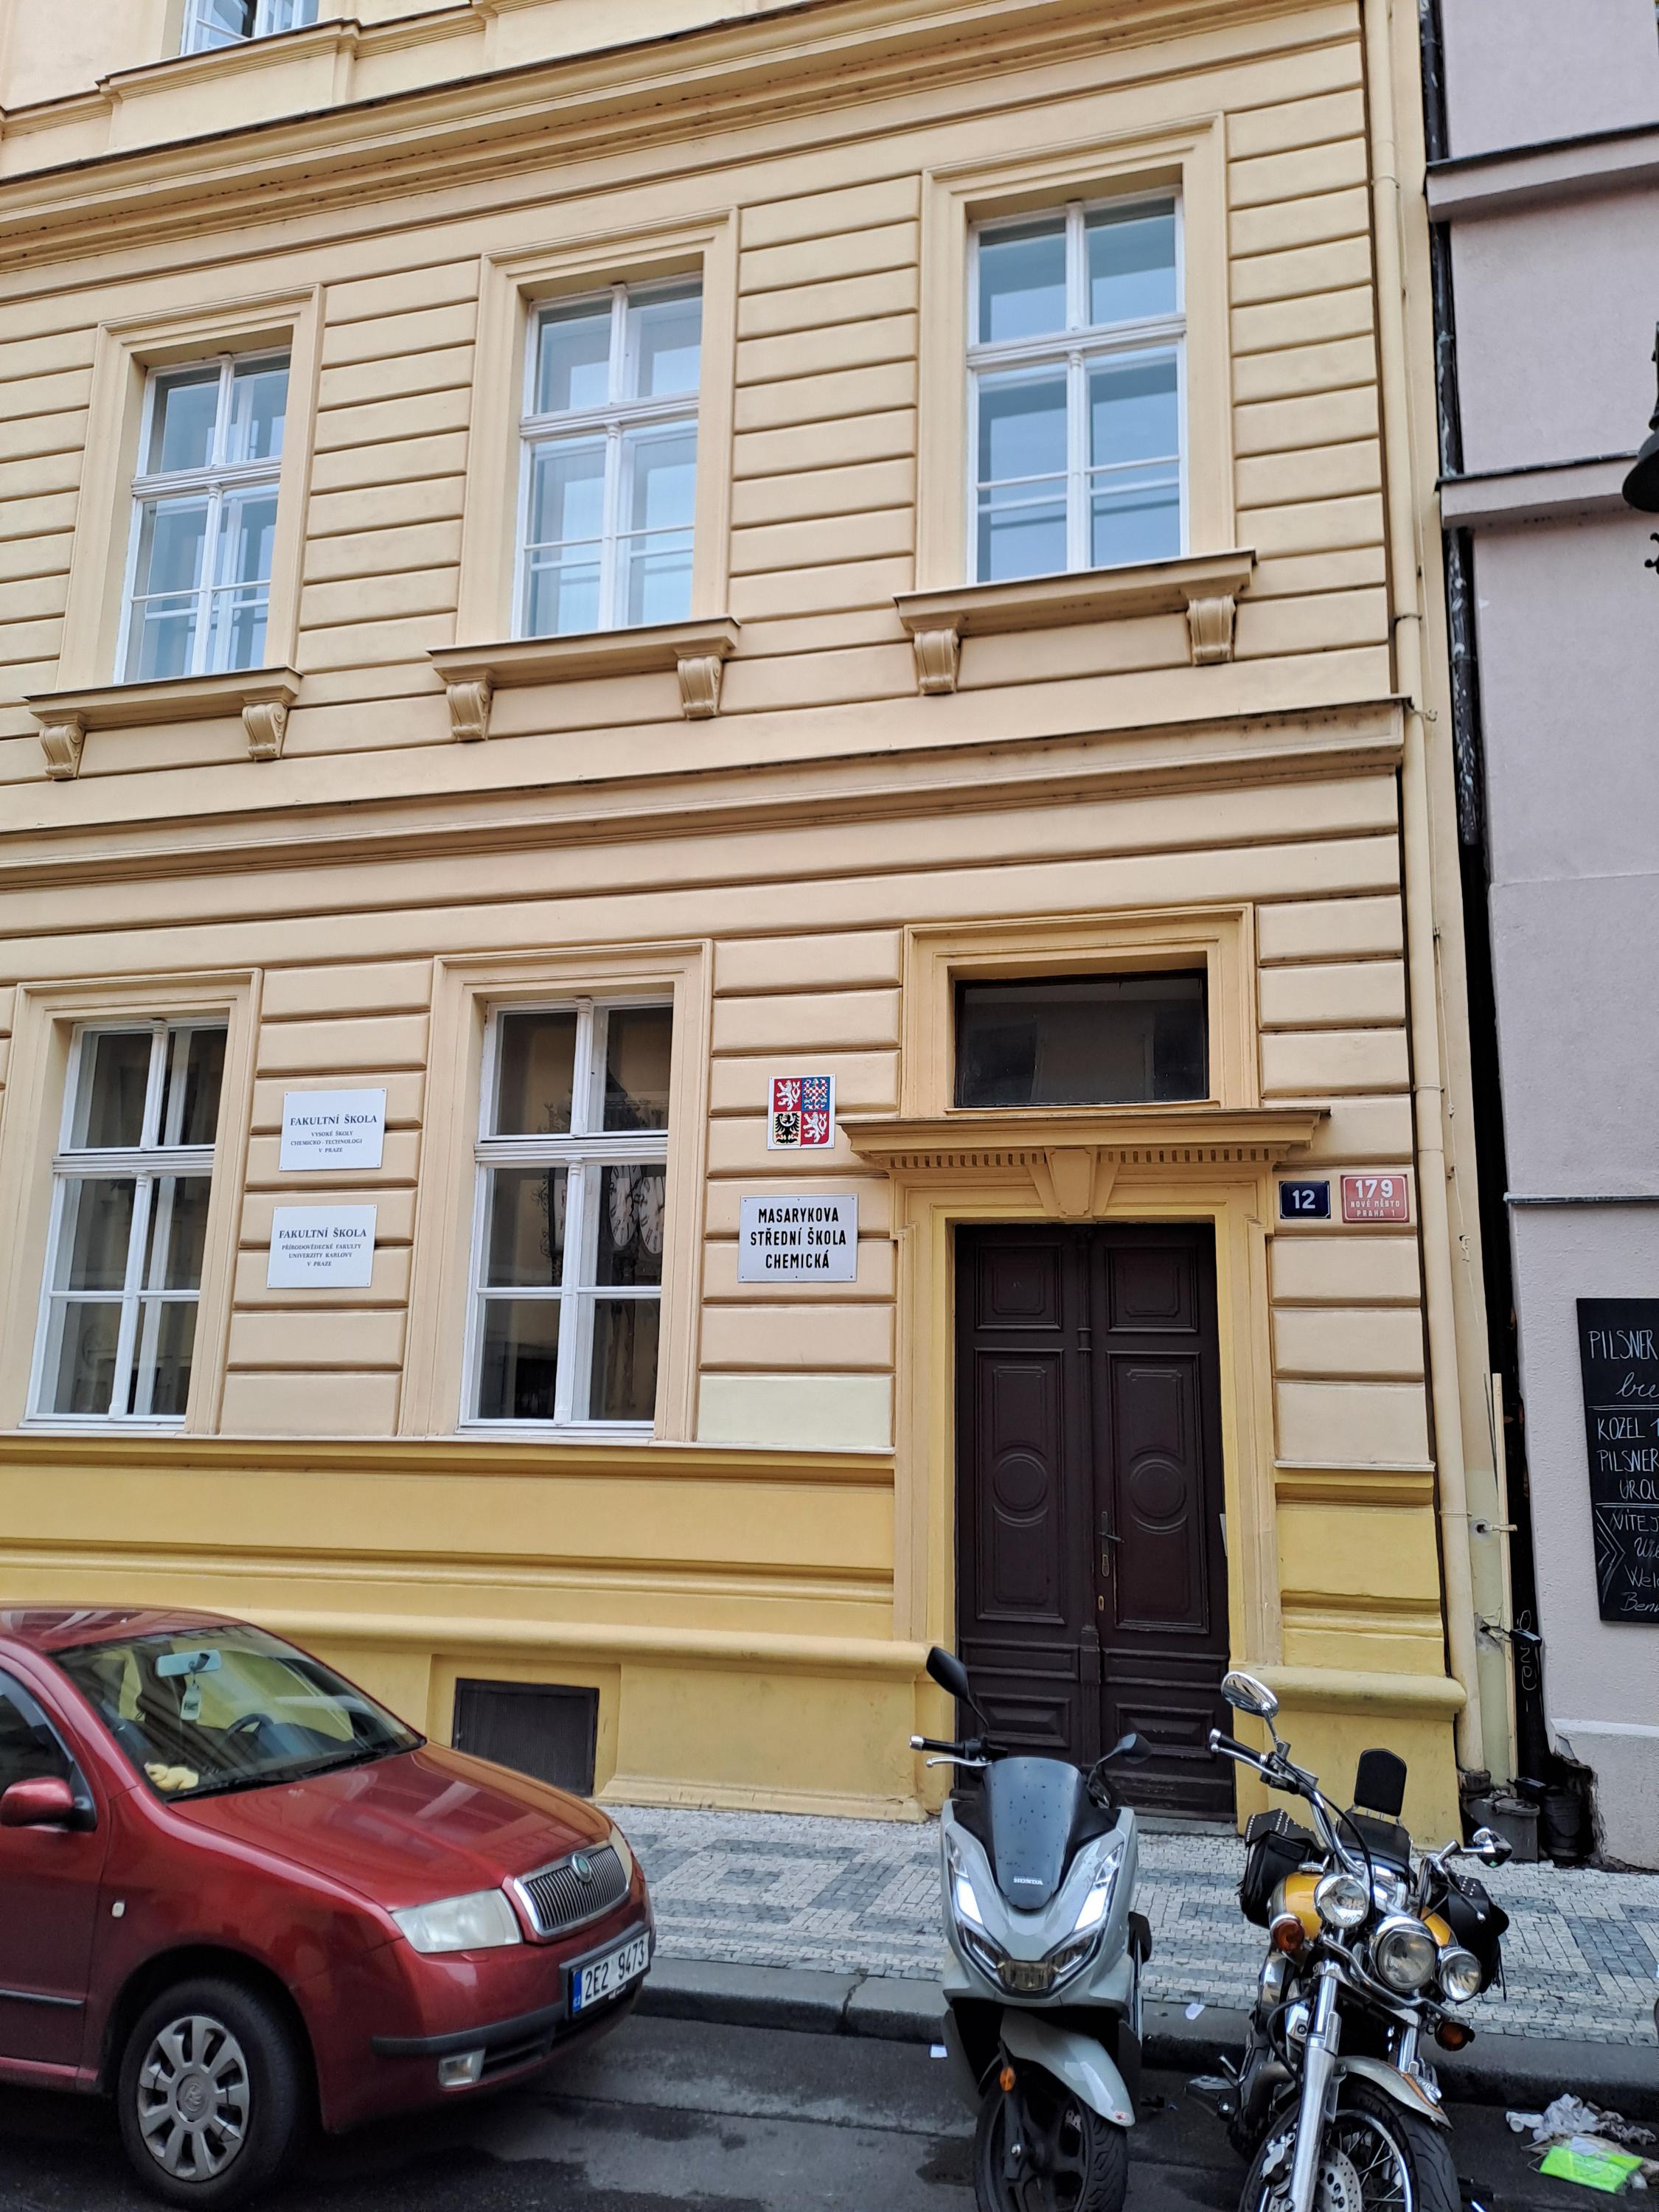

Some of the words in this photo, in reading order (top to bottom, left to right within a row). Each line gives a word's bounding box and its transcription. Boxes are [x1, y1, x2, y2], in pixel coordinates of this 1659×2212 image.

[290, 1114, 339, 1126] FAKULTNÍ
[344, 1114, 377, 1124] ŠKOLA
[1355, 1179, 1394, 1198] 179
[1292, 1189, 1316, 1209] 12
[1351, 1200, 1371, 1208] NOVÉ
[1374, 1198, 1400, 1208] MĚSTO
[758, 1207, 839, 1224] MASARYKOVA
[279, 1227, 329, 1239] FAKULTNÍ
[333, 1227, 366, 1237] ŠKOLA
[750, 1227, 802, 1246] STŘEDNÍ
[807, 1227, 846, 1245] ŠKOLA
[765, 1250, 830, 1269] CHEMICKÁ
[1587, 1329, 1658, 1360] PILSNER
[1597, 1416, 1646, 1441] KOZEL
[1596, 1448, 1659, 1473] PILSNER
[585, 1962, 608, 2000] 2E2
[619, 1940, 644, 1980] 9473
